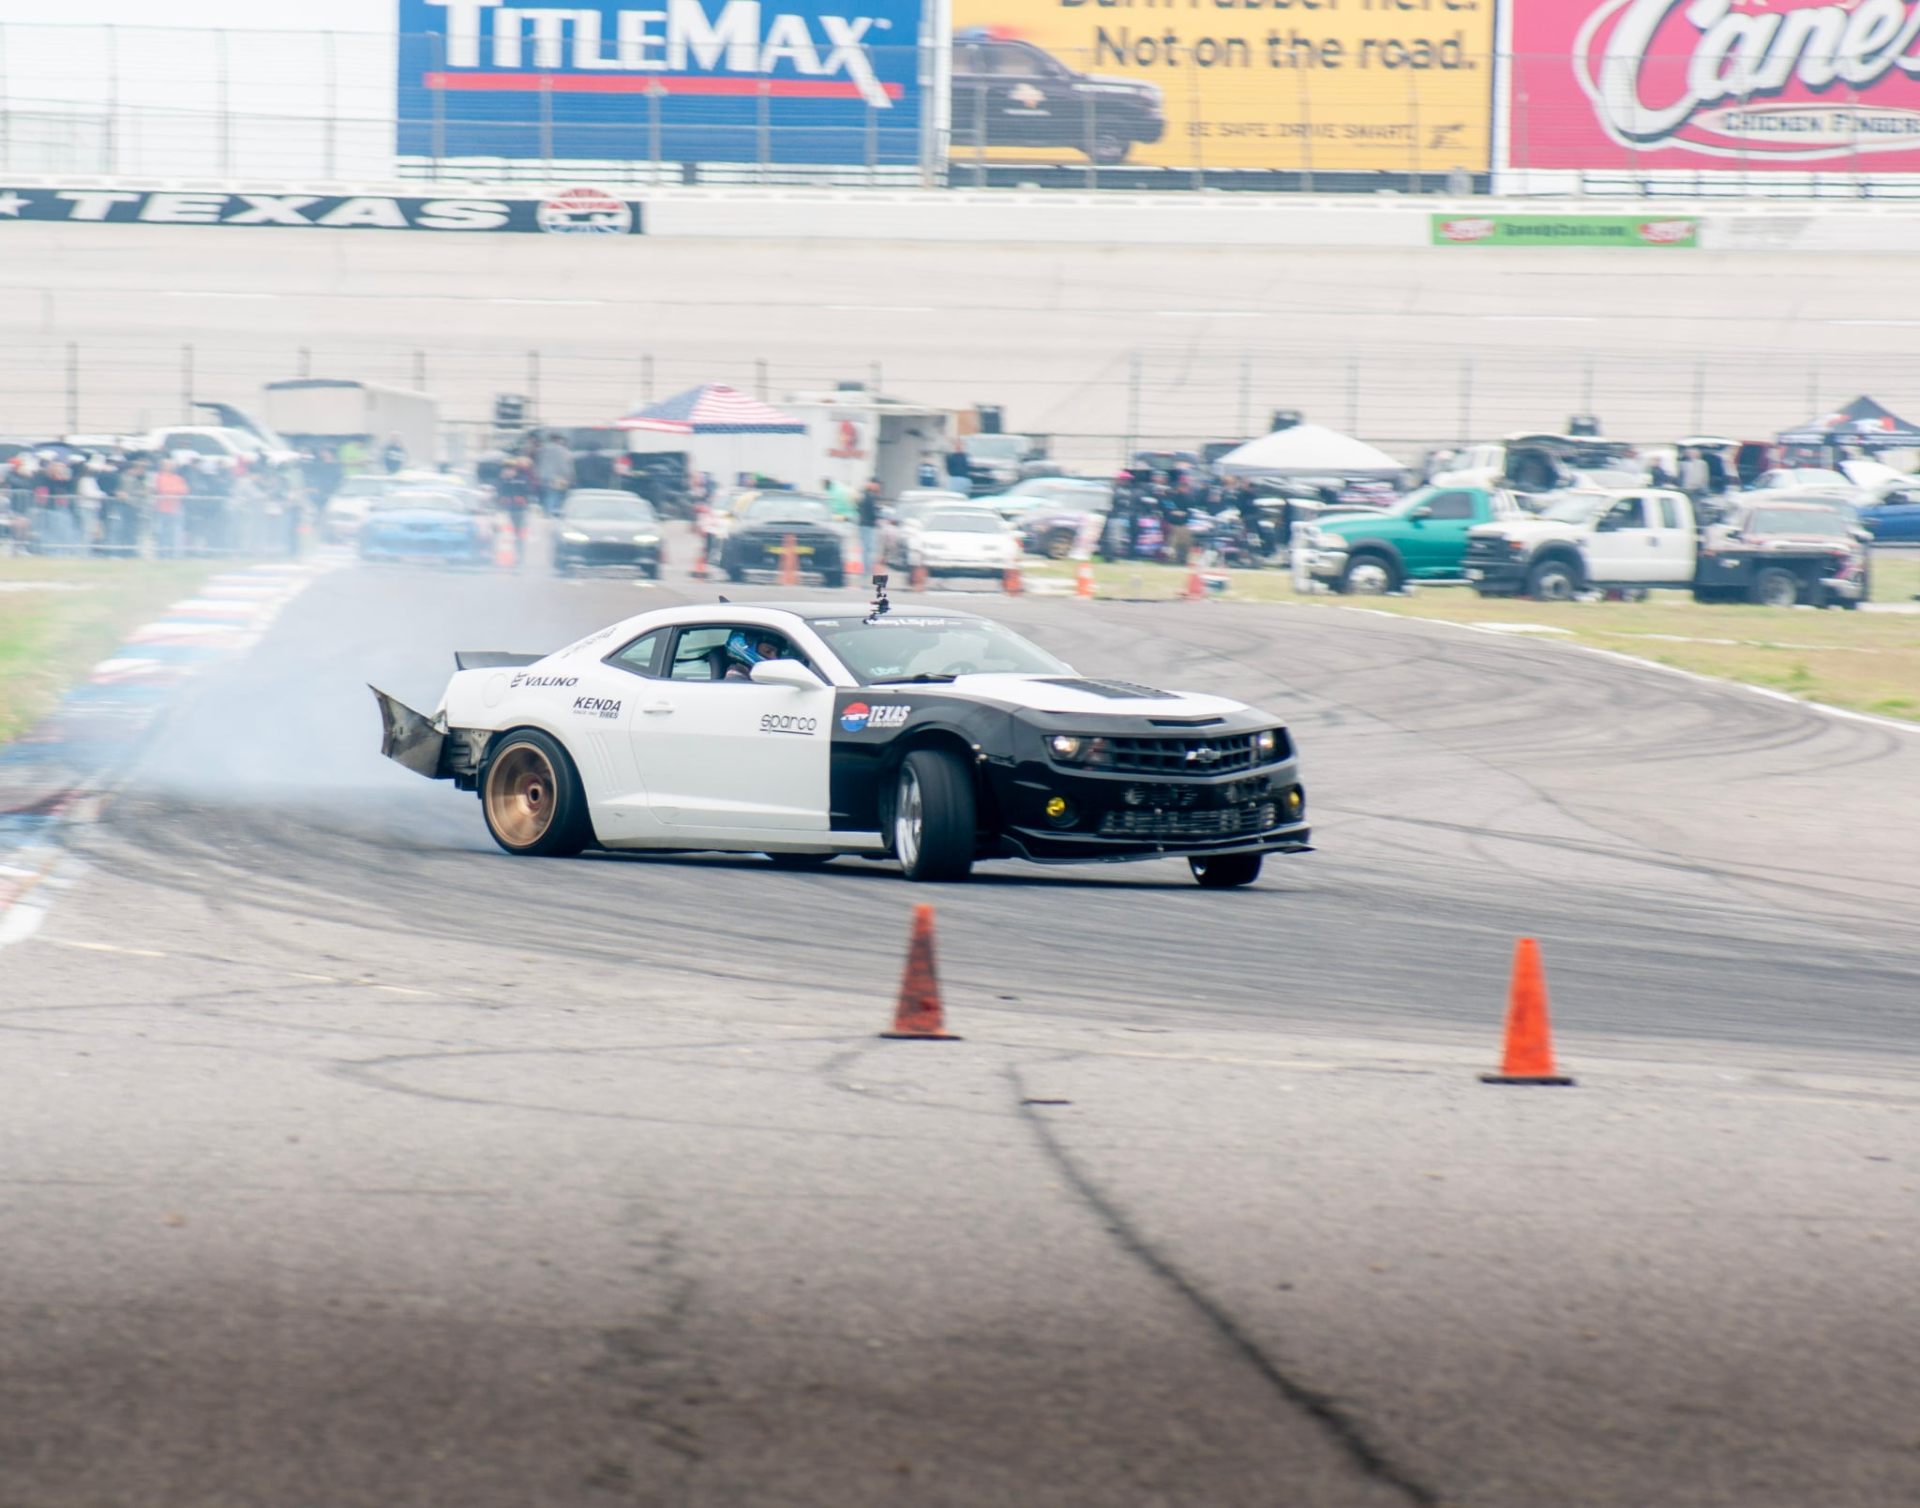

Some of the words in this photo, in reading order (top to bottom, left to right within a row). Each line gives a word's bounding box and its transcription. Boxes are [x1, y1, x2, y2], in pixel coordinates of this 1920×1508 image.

[1095, 26, 1178, 68] Not
[1196, 37, 1249, 68] on
[1267, 28, 1344, 69] the
[1359, 30, 1478, 70] road.
[1725, 111, 1823, 132] CHICKEN
[56, 191, 511, 230] TEXAS
[525, 676, 579, 687] VALINO
[573, 696, 622, 711] KENDA
[868, 705, 911, 721] TEXAS
[761, 713, 817, 733] sparco
